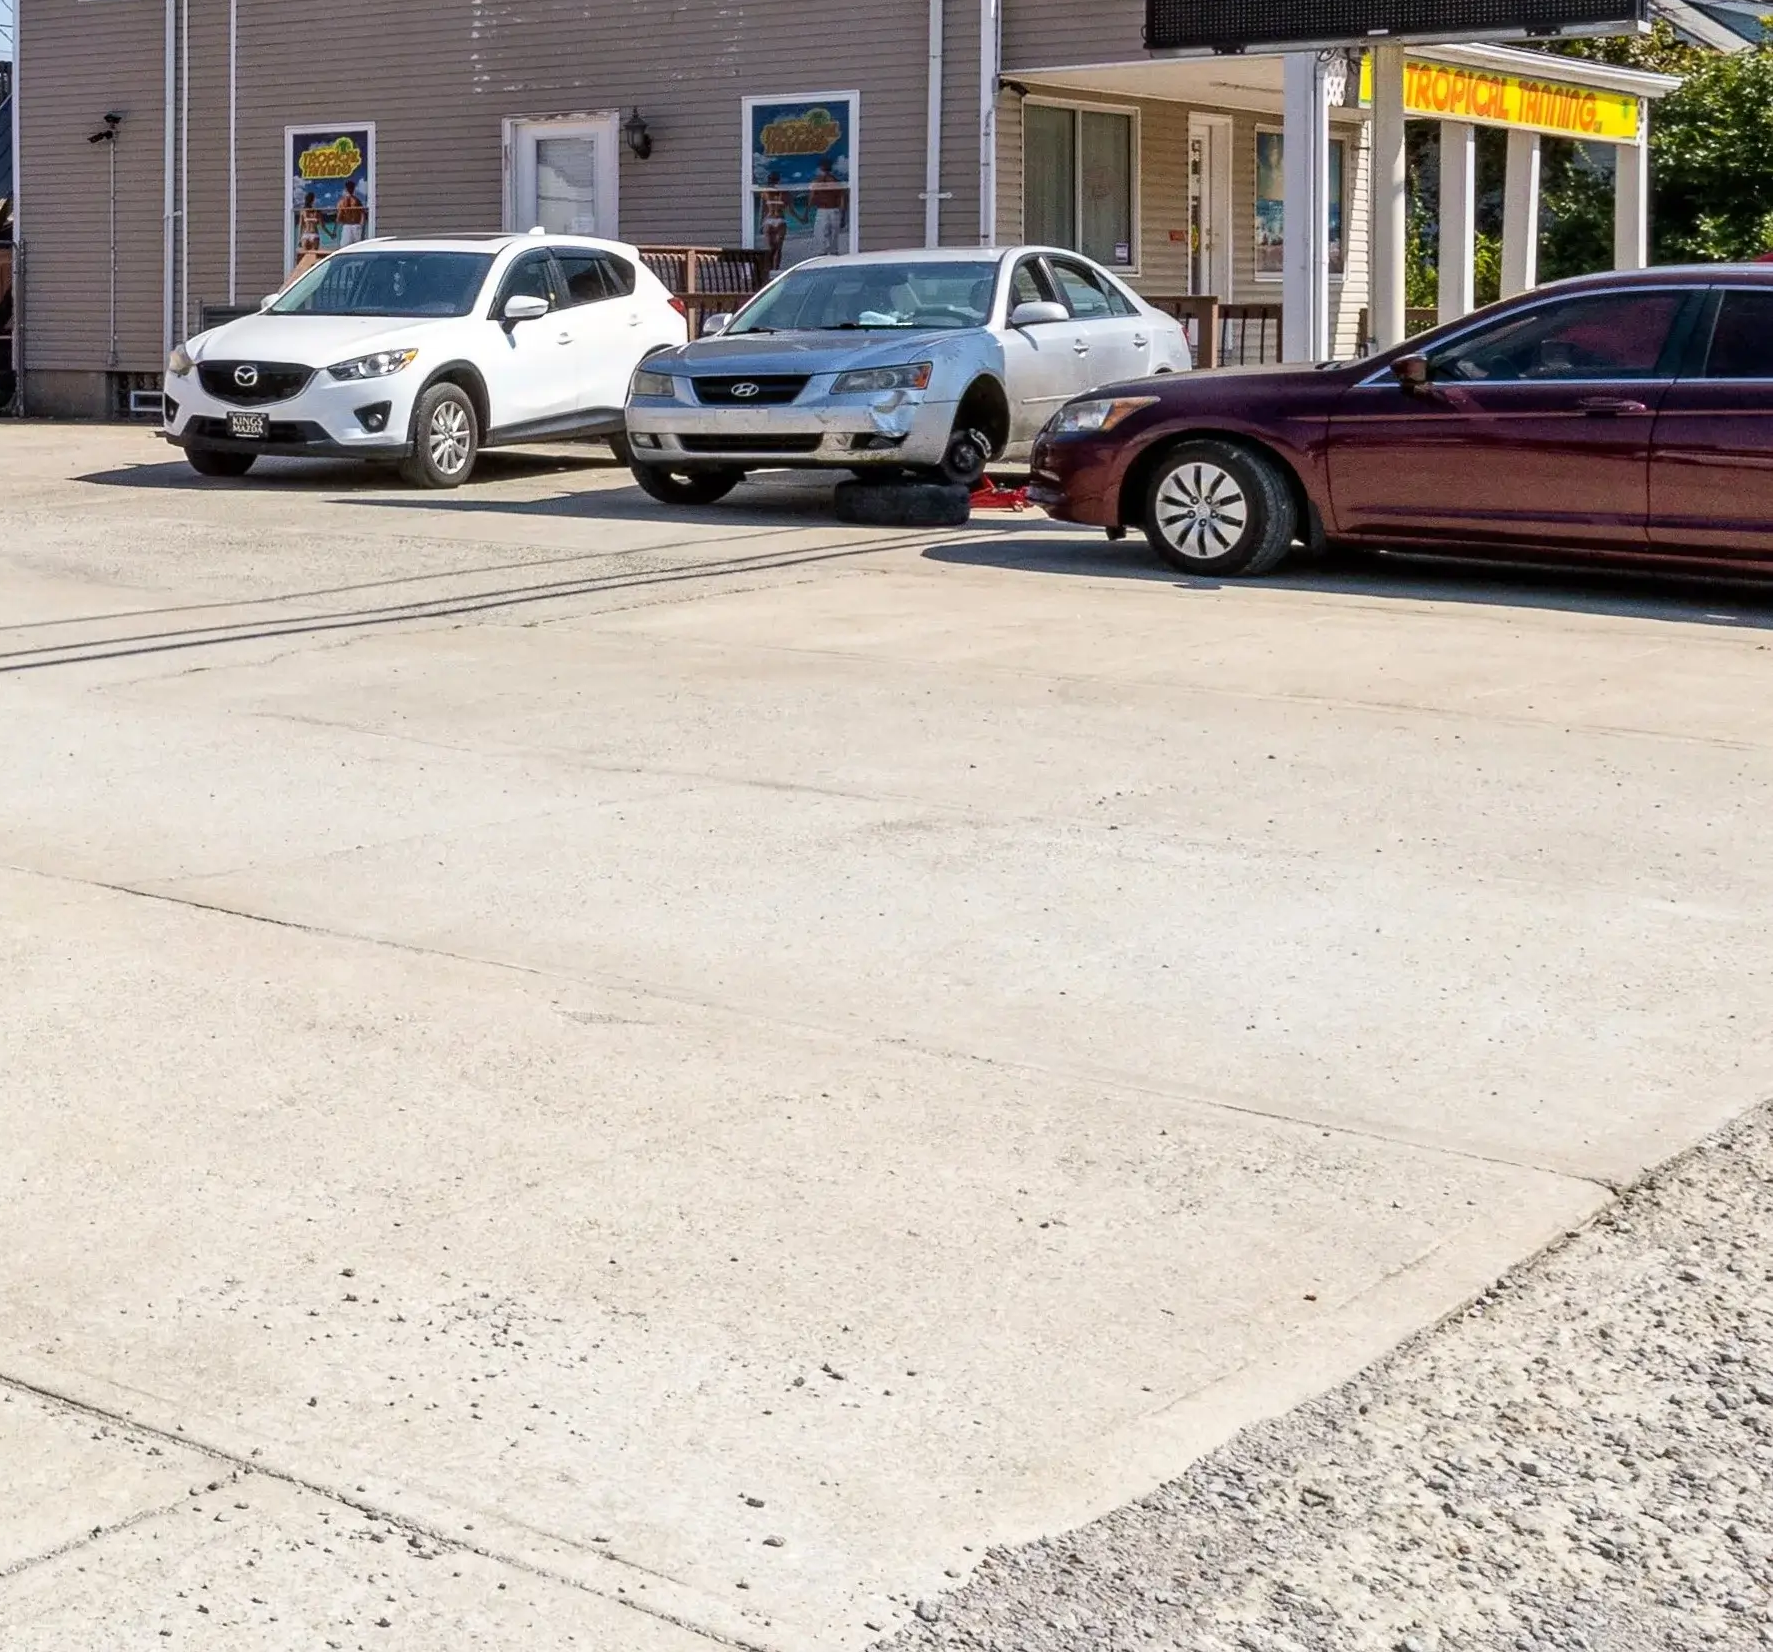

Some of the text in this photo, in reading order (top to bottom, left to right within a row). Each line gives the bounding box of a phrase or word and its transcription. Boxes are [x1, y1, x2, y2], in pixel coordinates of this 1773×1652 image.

[1405, 61, 1509, 119] TROPICAL
[232, 416, 263, 426] KINGS
[232, 425, 263, 434] MAZDA
